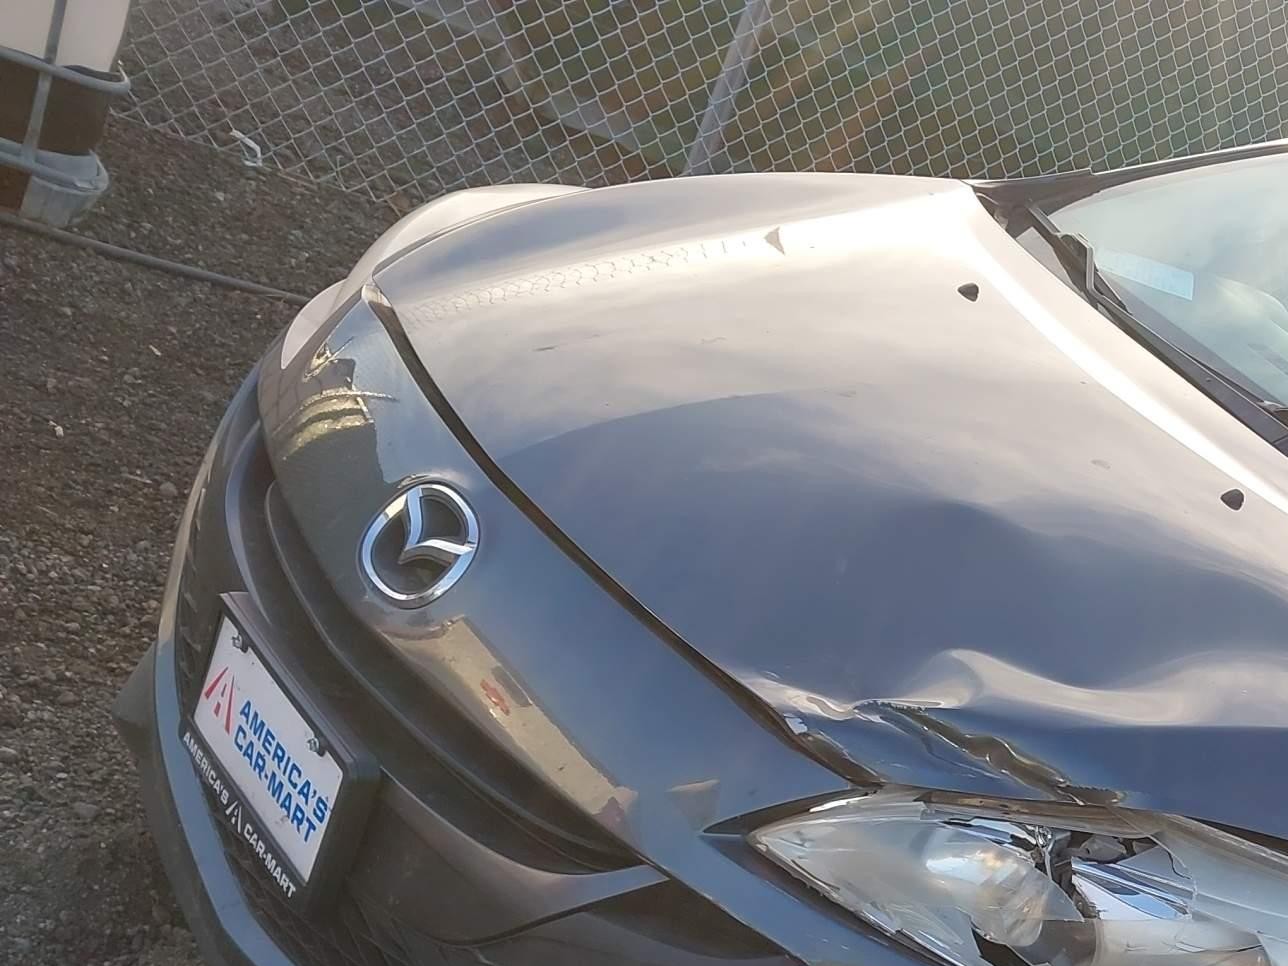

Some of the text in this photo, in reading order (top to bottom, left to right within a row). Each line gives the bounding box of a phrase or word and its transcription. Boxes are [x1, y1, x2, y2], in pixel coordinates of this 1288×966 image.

[183, 732, 297, 898] AMERICA'S CAR-MART
[233, 727, 317, 842] CAR-MART
[239, 700, 328, 825] AMERICA'S
